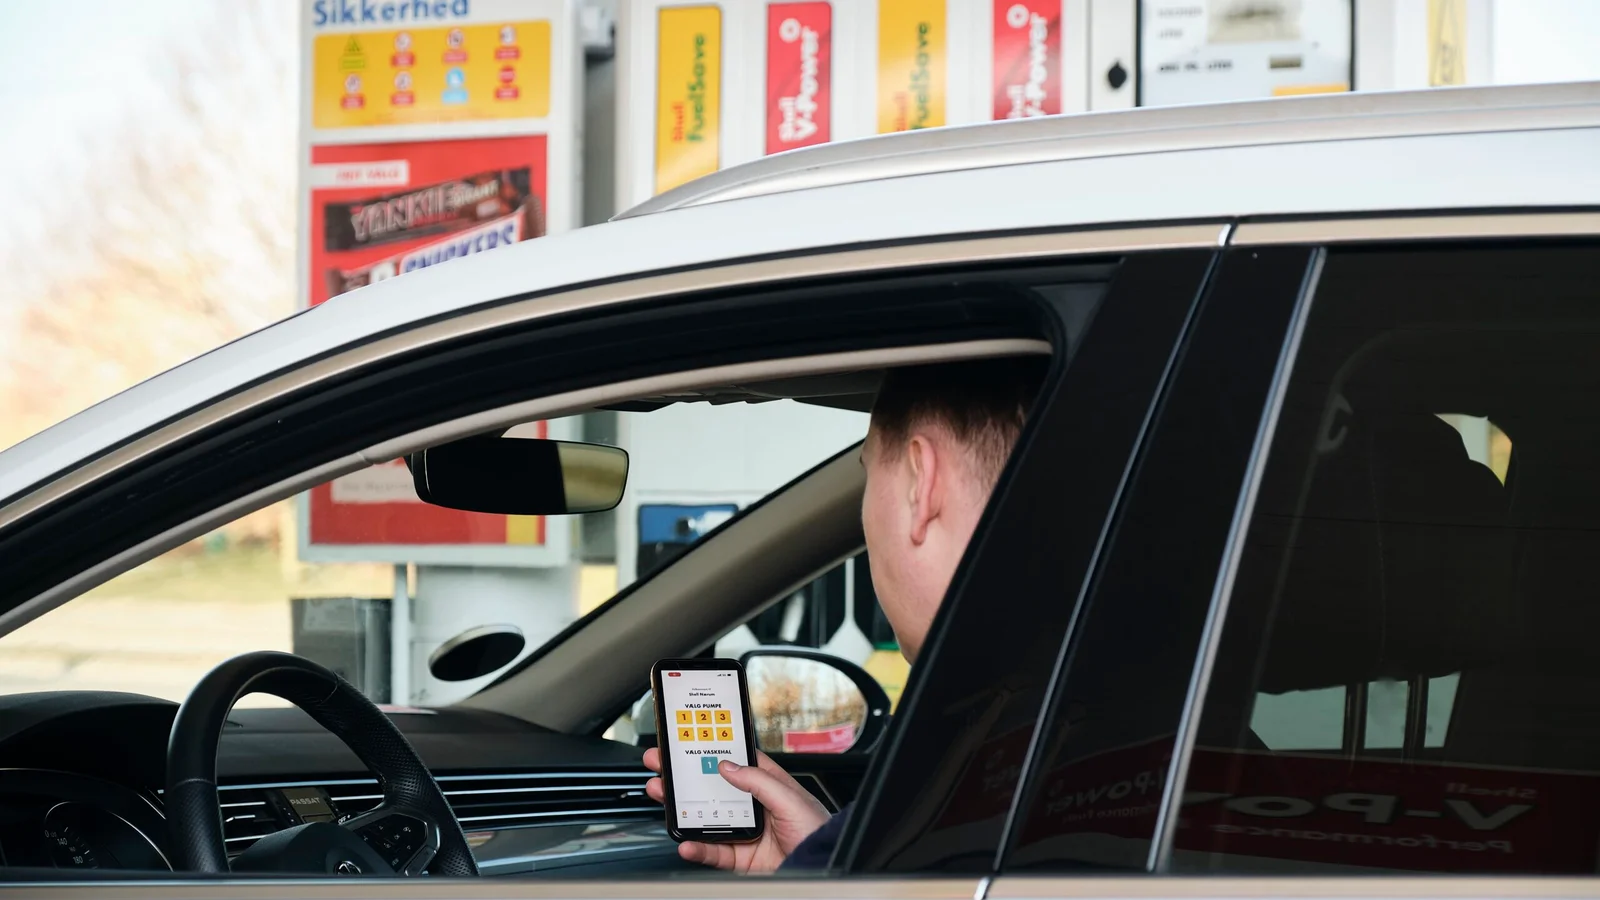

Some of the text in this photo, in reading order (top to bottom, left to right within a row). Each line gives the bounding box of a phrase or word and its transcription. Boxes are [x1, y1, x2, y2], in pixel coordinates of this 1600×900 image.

[313, 0, 468, 26] Sikkerhed
[794, 26, 819, 139] V-Power
[779, 97, 796, 141] Shell
[290, 797, 320, 805] PASSAT
[338, 817, 347, 825] OFF
[57, 837, 68, 845] 140
